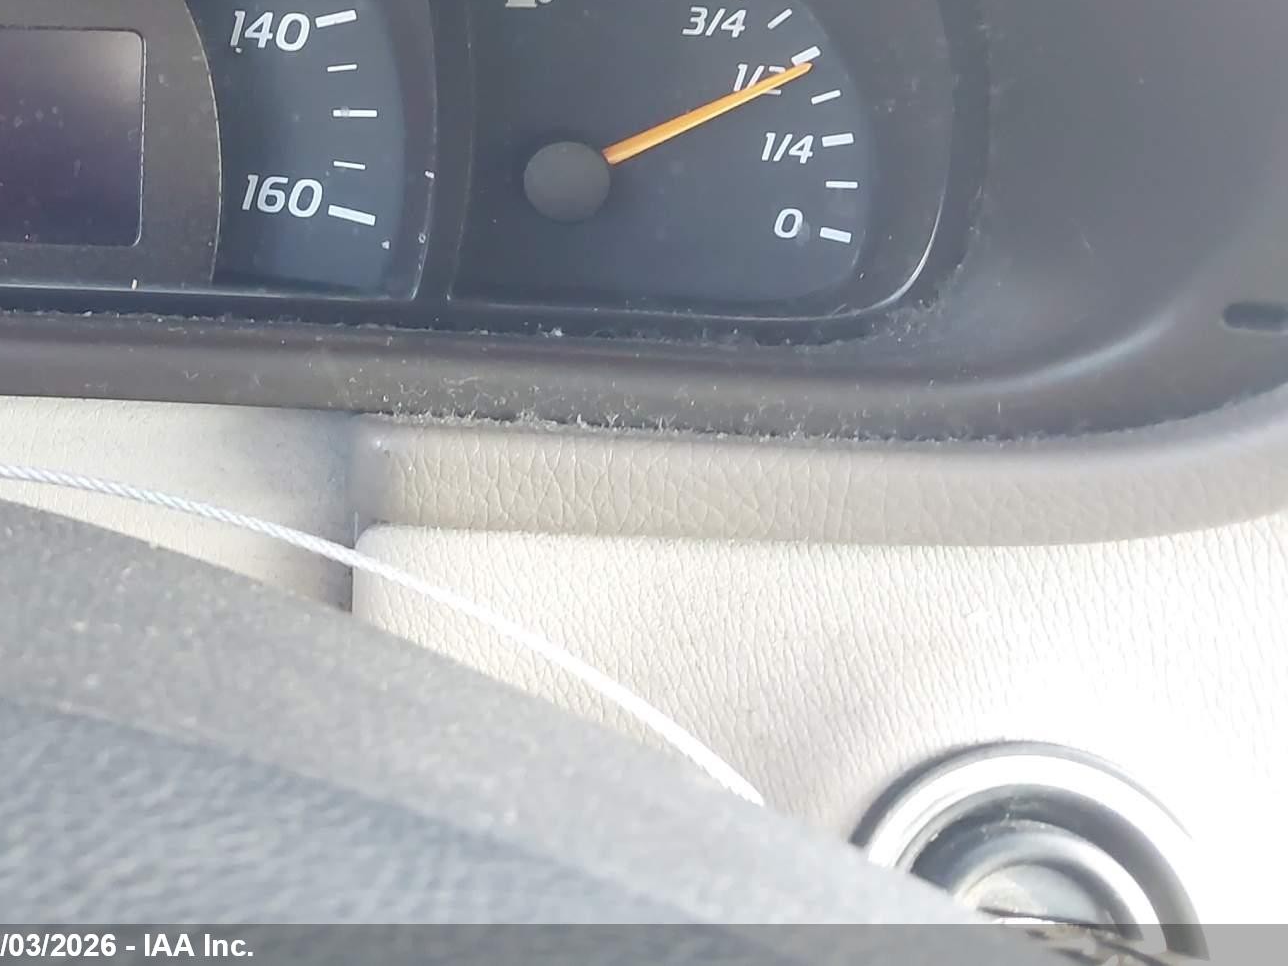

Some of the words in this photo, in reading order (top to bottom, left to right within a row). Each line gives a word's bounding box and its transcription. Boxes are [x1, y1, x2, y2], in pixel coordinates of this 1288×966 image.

[229, 10, 311, 52] 140
[682, 6, 746, 37] 3/4
[761, 132, 813, 164] 1/4
[241, 174, 324, 218] 160
[773, 208, 803, 238] 0
